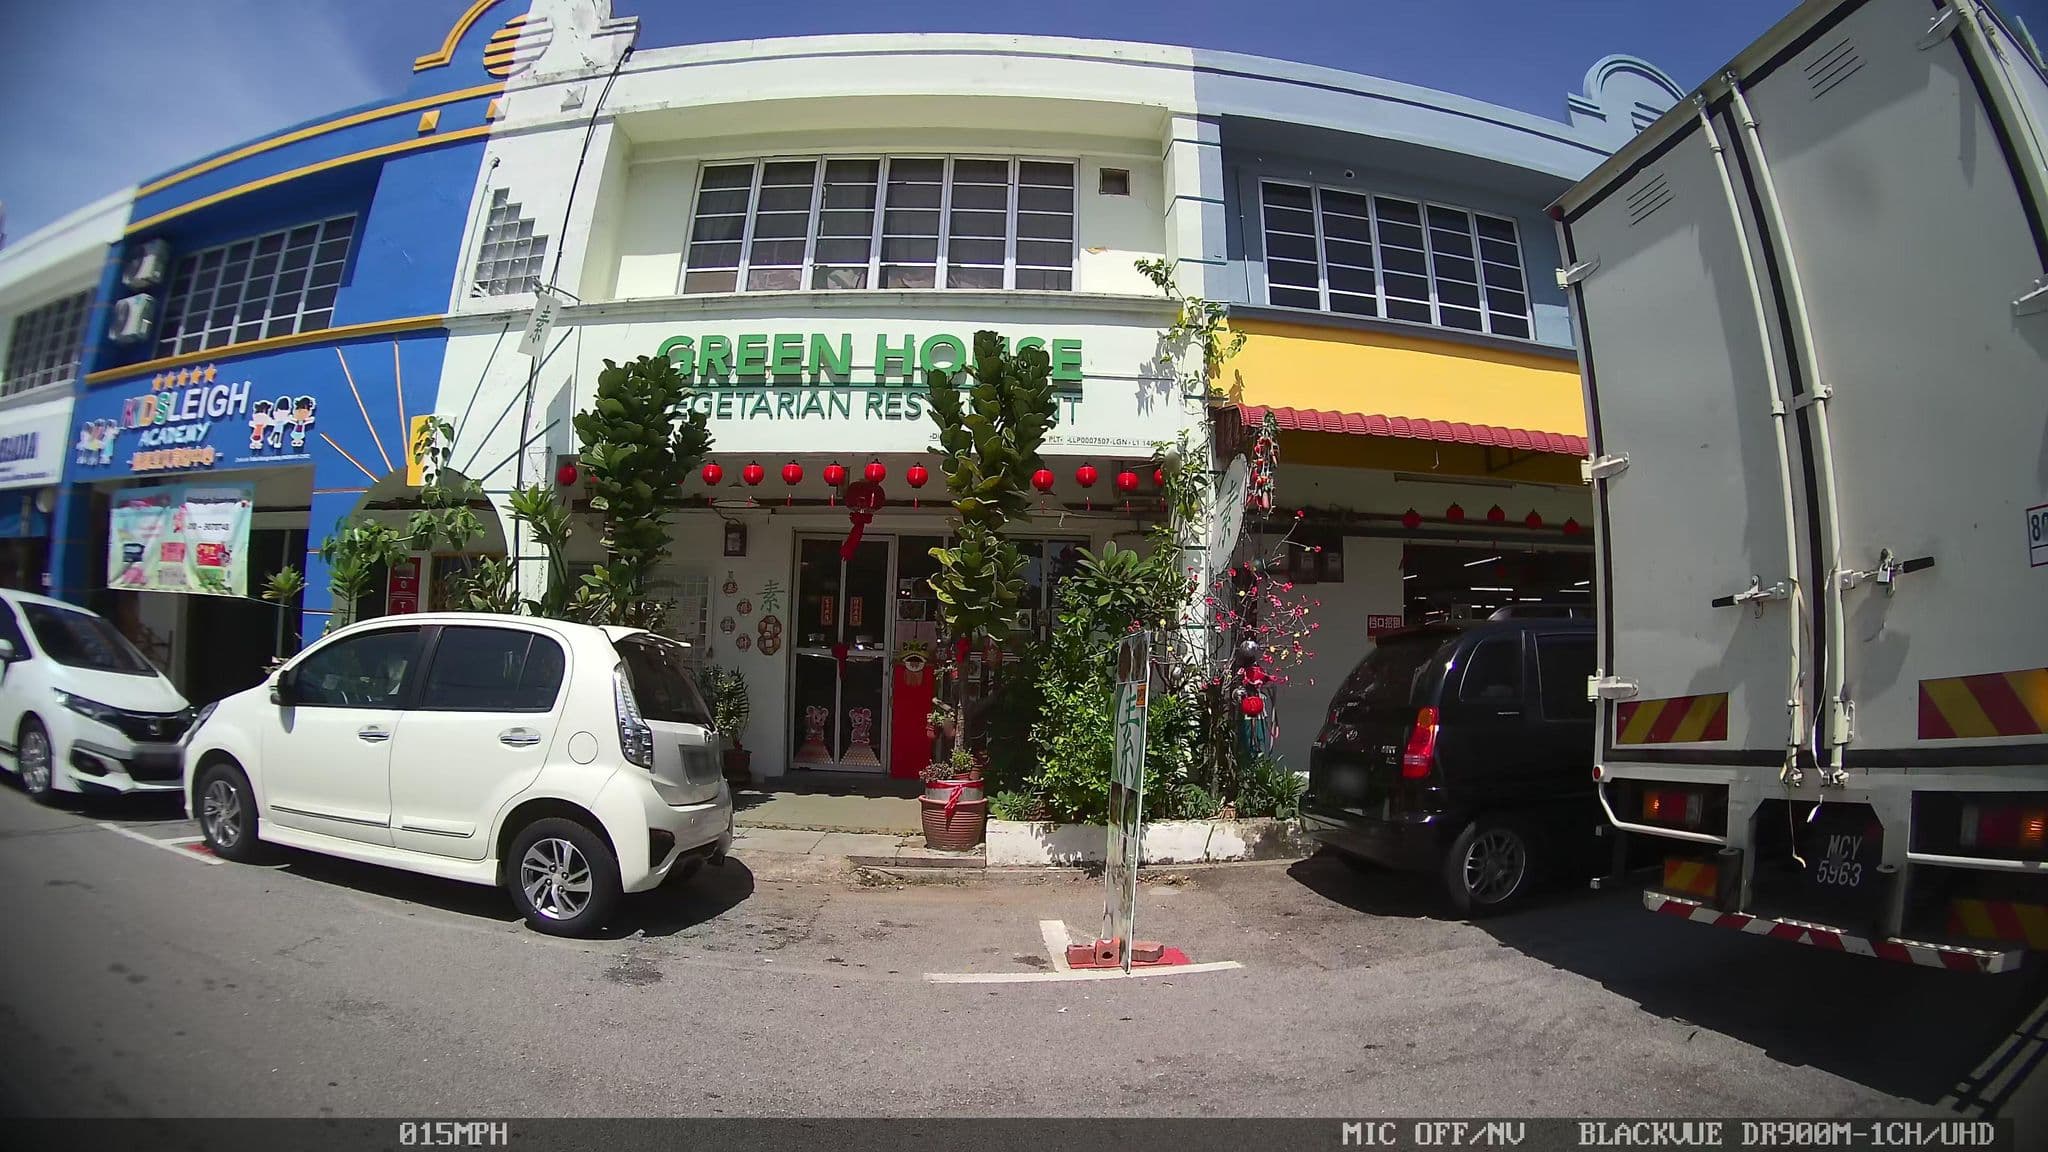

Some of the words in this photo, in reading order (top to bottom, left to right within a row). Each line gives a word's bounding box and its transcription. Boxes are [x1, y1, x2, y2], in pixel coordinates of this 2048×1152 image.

[656, 333, 852, 376] GREEN
[874, 333, 1083, 381] HOE
[122, 381, 251, 429] KIDSLEIGH
[673, 391, 851, 420] EGETARIAN
[756, 579, 785, 612] 素
[1826, 834, 1863, 860] MCY
[1816, 859, 1862, 887] 5963
